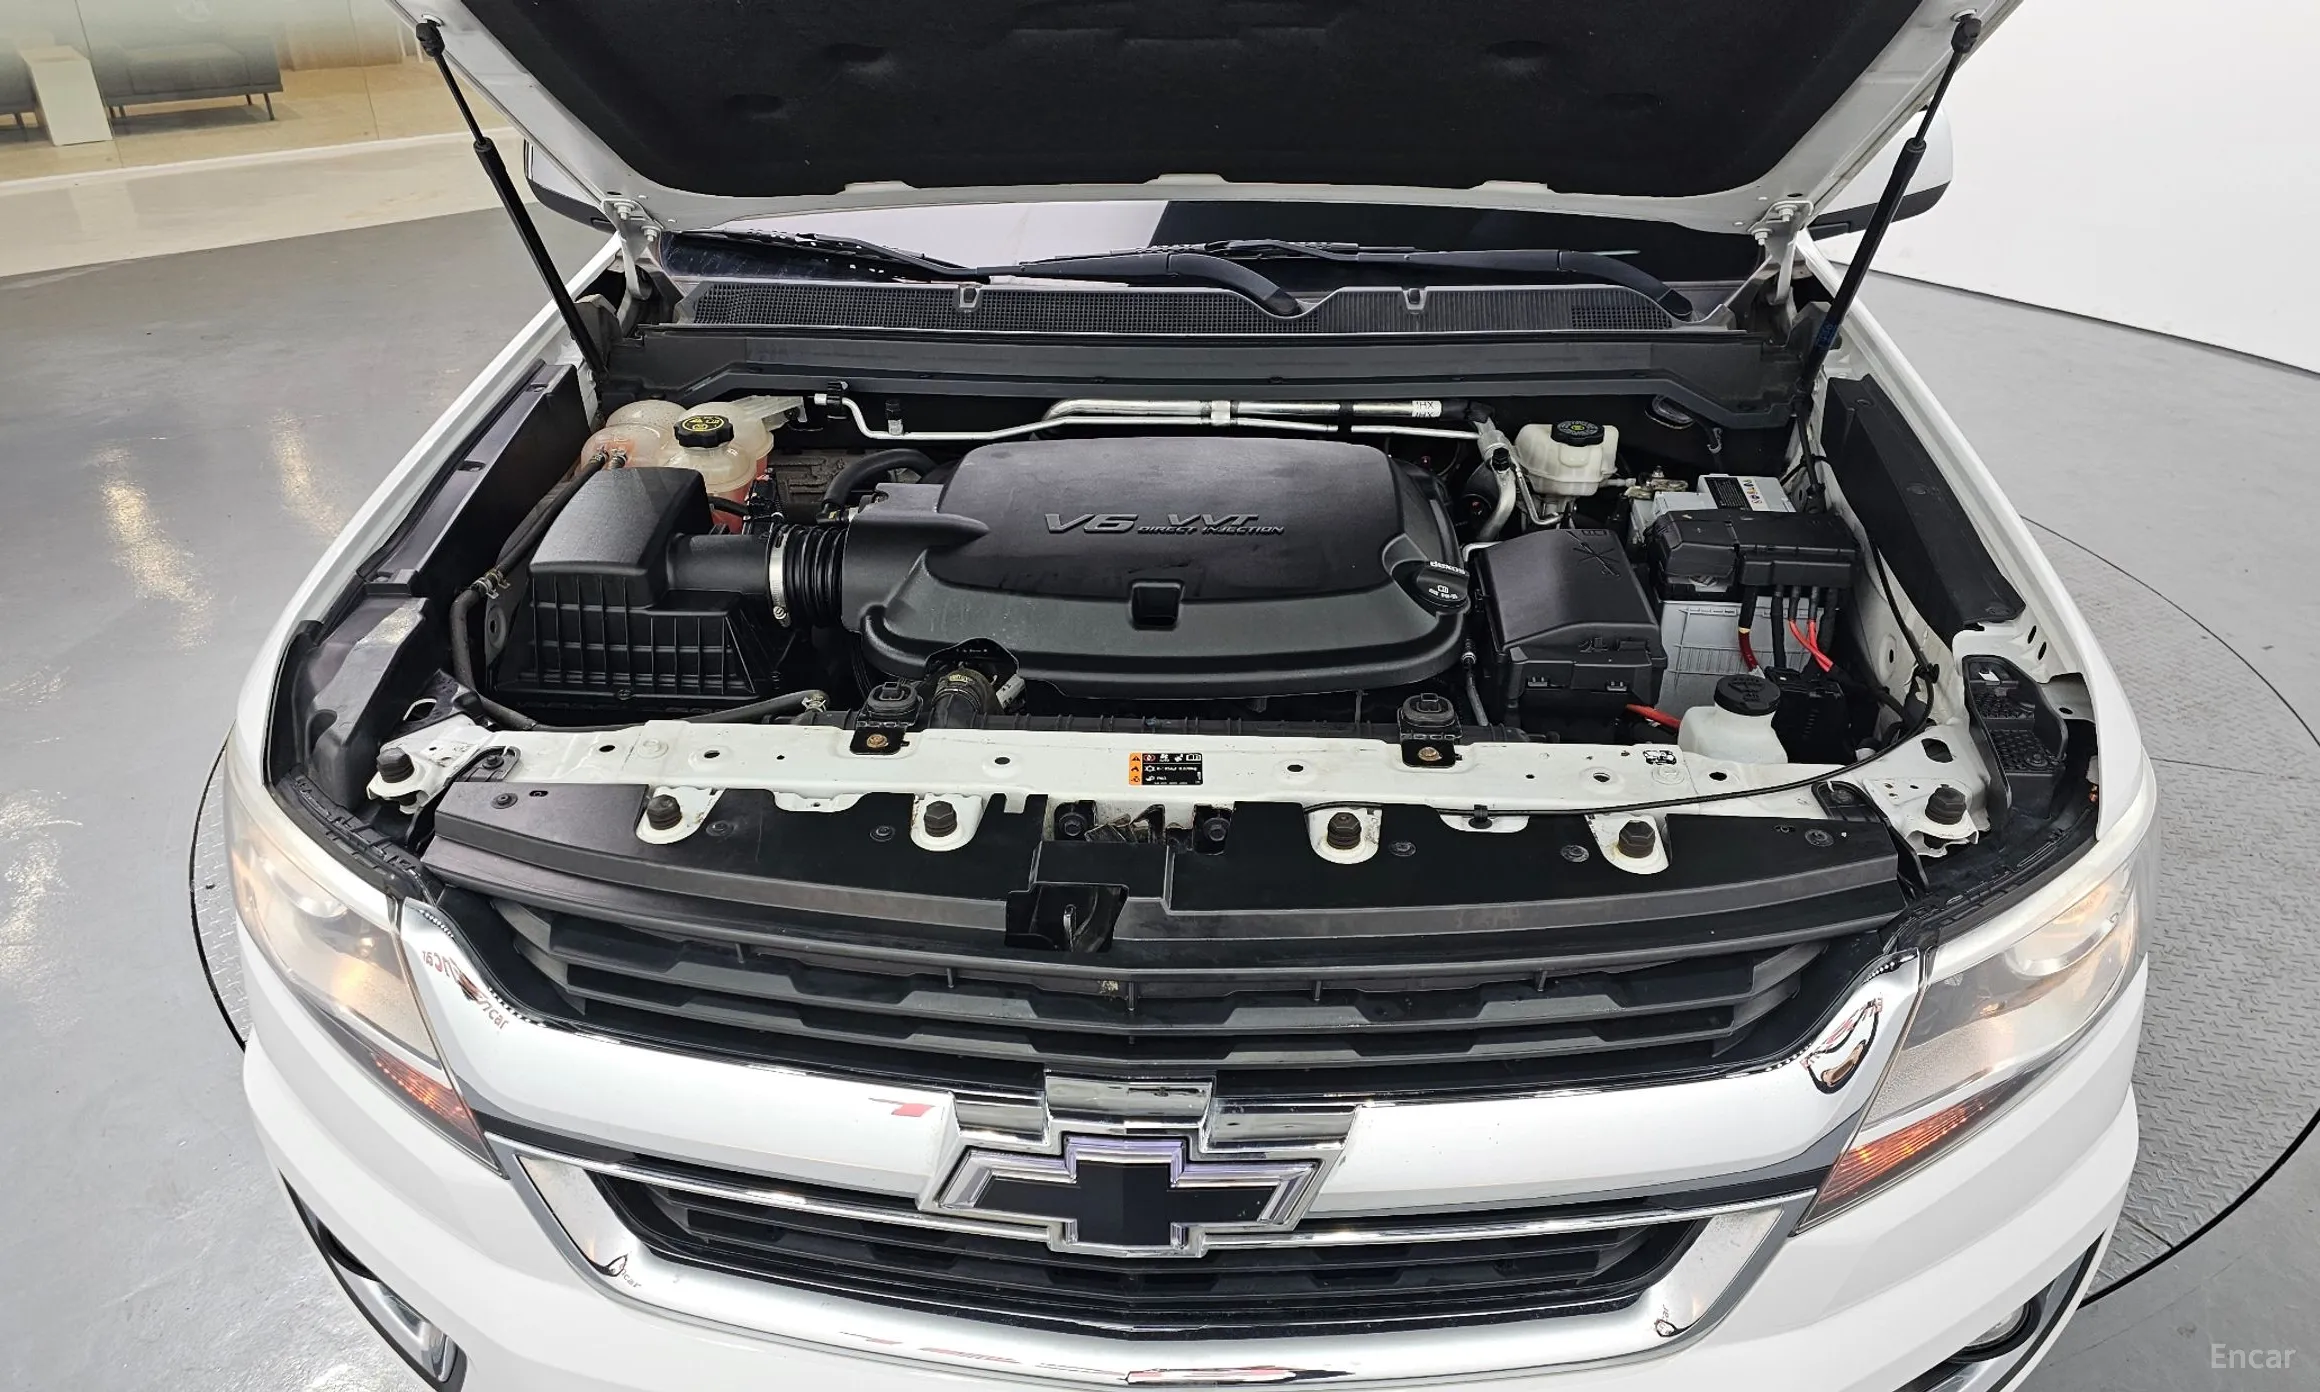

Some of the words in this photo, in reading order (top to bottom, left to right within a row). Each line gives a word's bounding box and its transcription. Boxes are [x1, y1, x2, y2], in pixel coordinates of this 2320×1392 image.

[1045, 513, 1139, 533] V6
[1168, 513, 1259, 527] VVT
[1138, 526, 1198, 535] DIRECT
[1201, 526, 1285, 535] INJECTION
